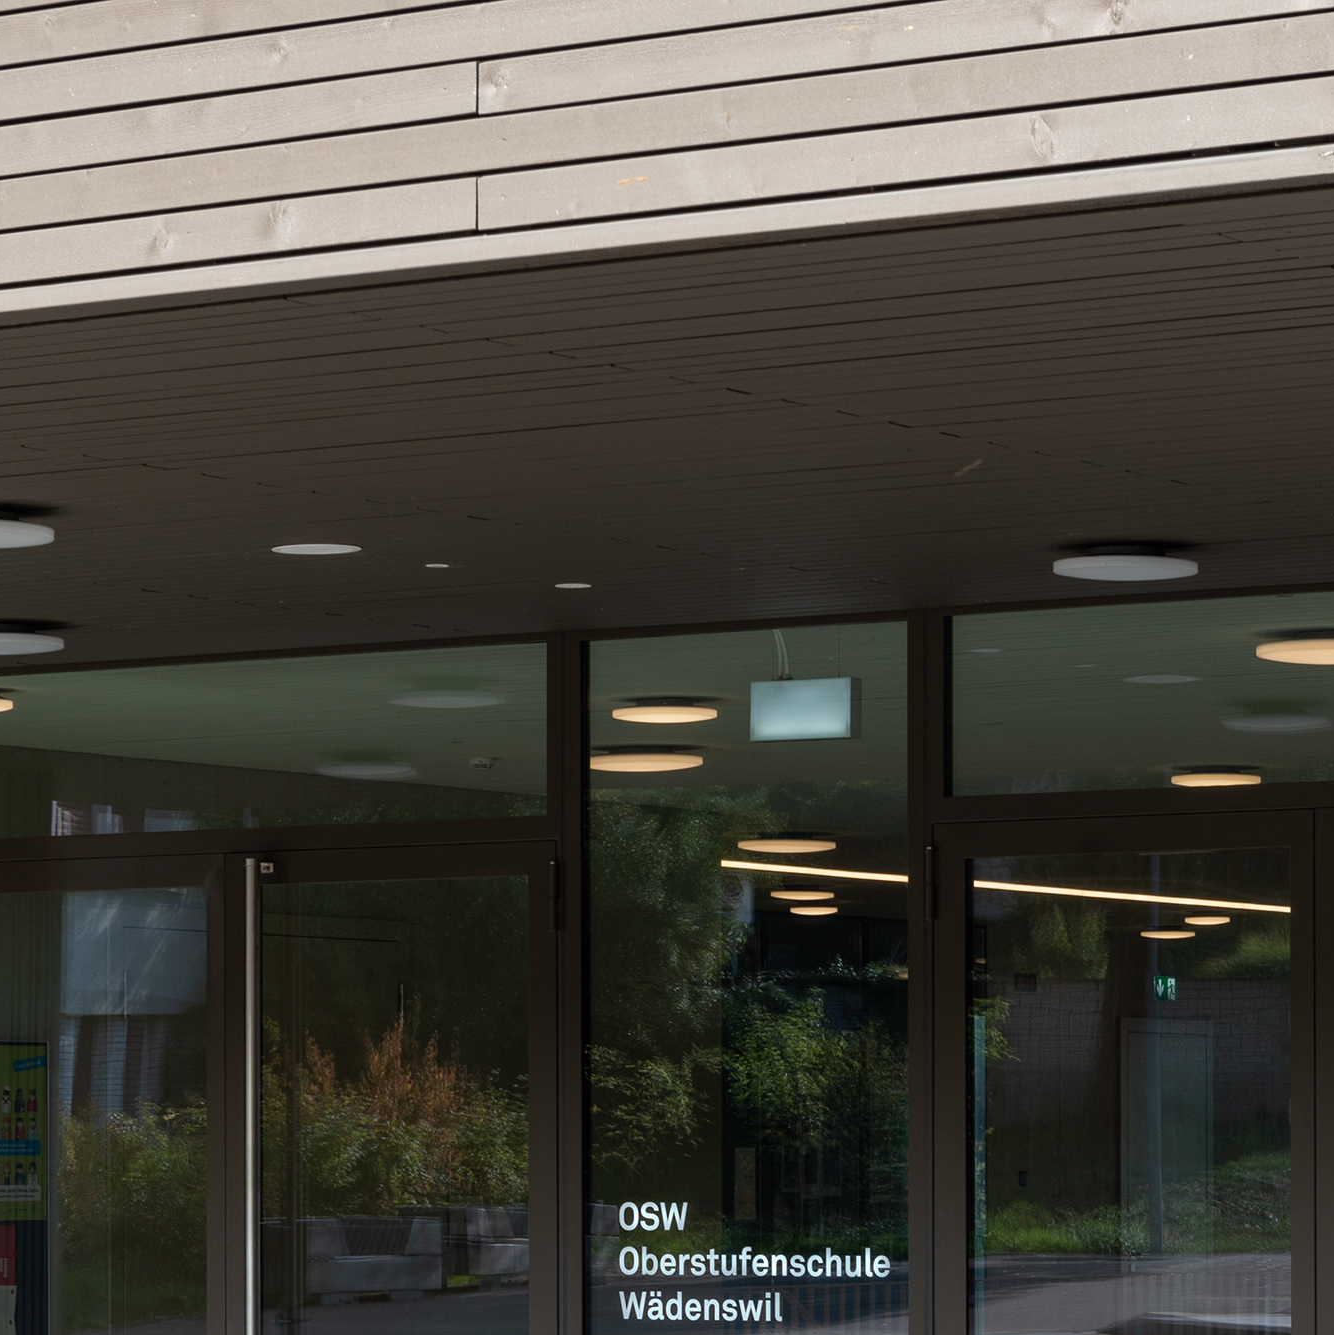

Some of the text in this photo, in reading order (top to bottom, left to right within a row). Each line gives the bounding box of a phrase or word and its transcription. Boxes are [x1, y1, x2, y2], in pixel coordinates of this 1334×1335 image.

[619, 1202, 688, 1231] OSW
[619, 1246, 890, 1277] Oberstufenschule
[619, 1291, 782, 1321] Wädenswil
